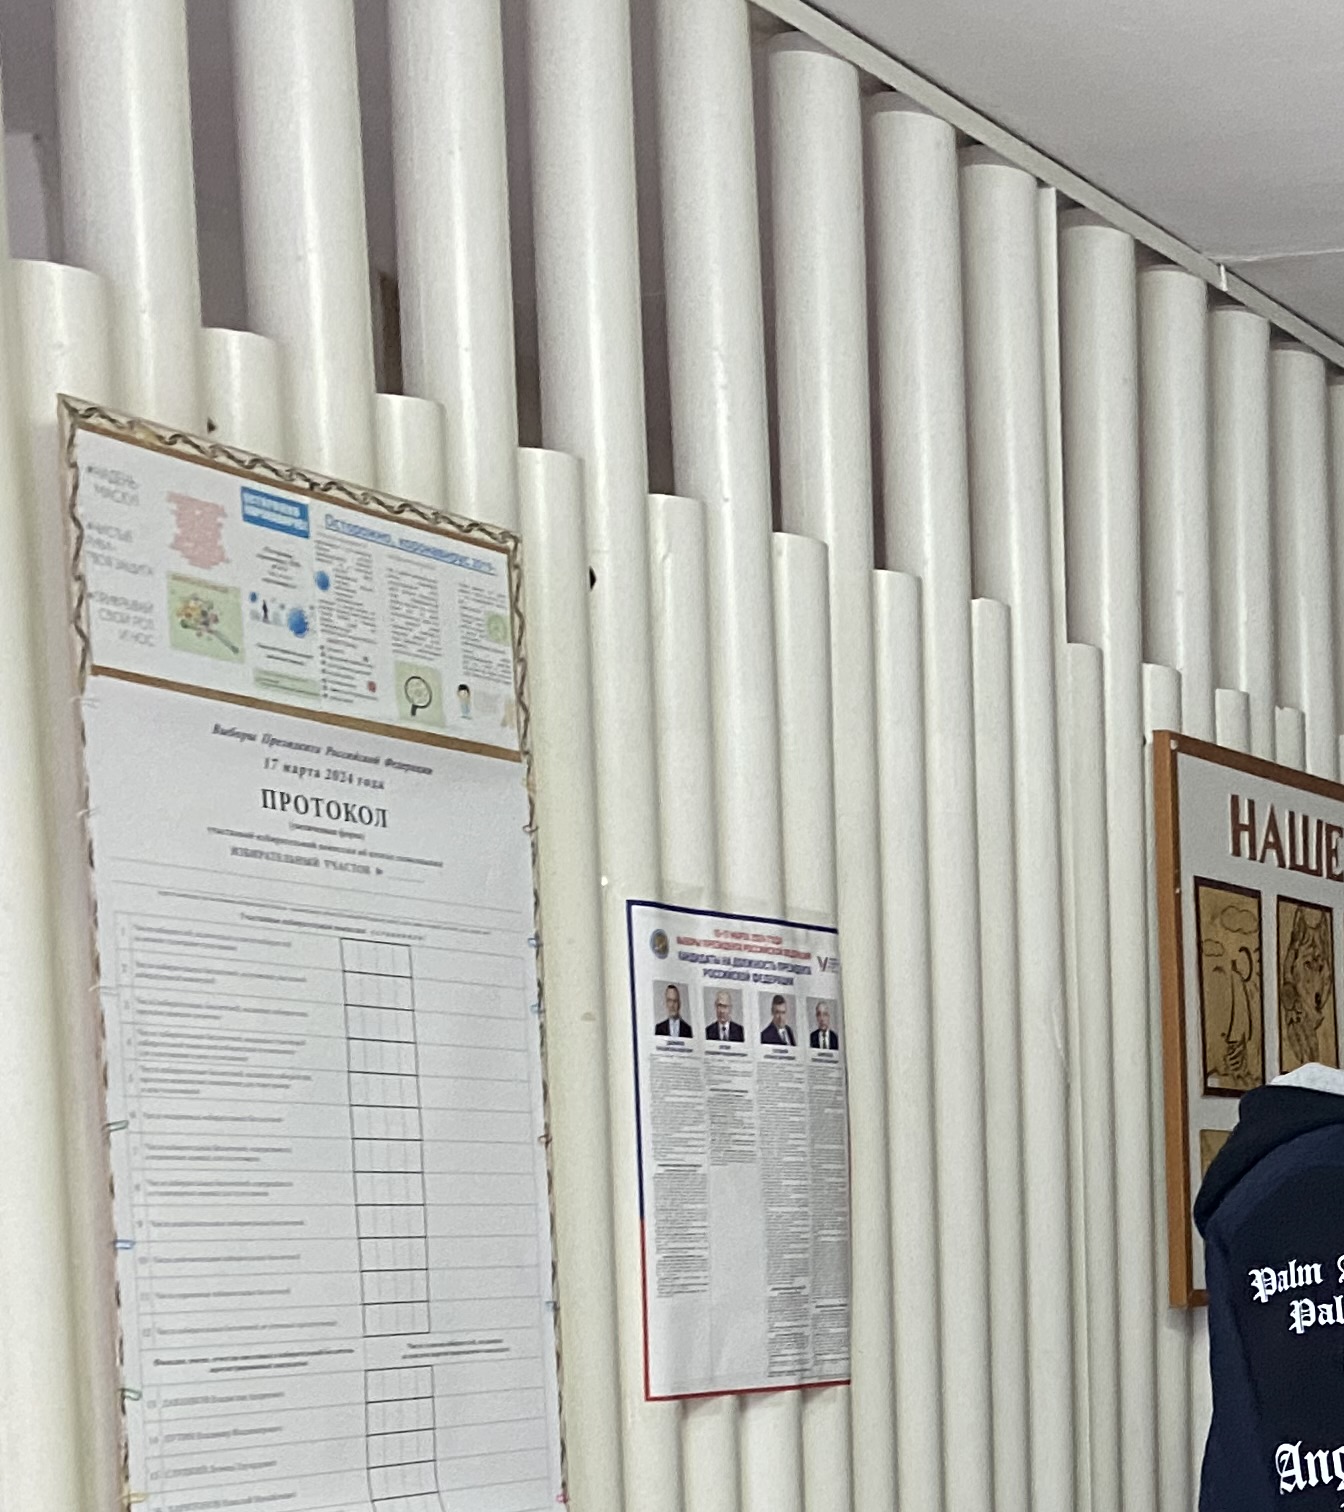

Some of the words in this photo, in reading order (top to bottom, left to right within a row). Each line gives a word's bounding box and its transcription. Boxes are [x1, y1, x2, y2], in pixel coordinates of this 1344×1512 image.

[263, 757, 279, 770] 17
[282, 763, 321, 779] марта
[324, 768, 354, 785] 2024
[356, 776, 385, 790] года
[261, 788, 389, 829] ПРОТОКОЛ
[1229, 794, 1344, 883] НАШЕ
[1248, 1259, 1323, 1303] Palm
